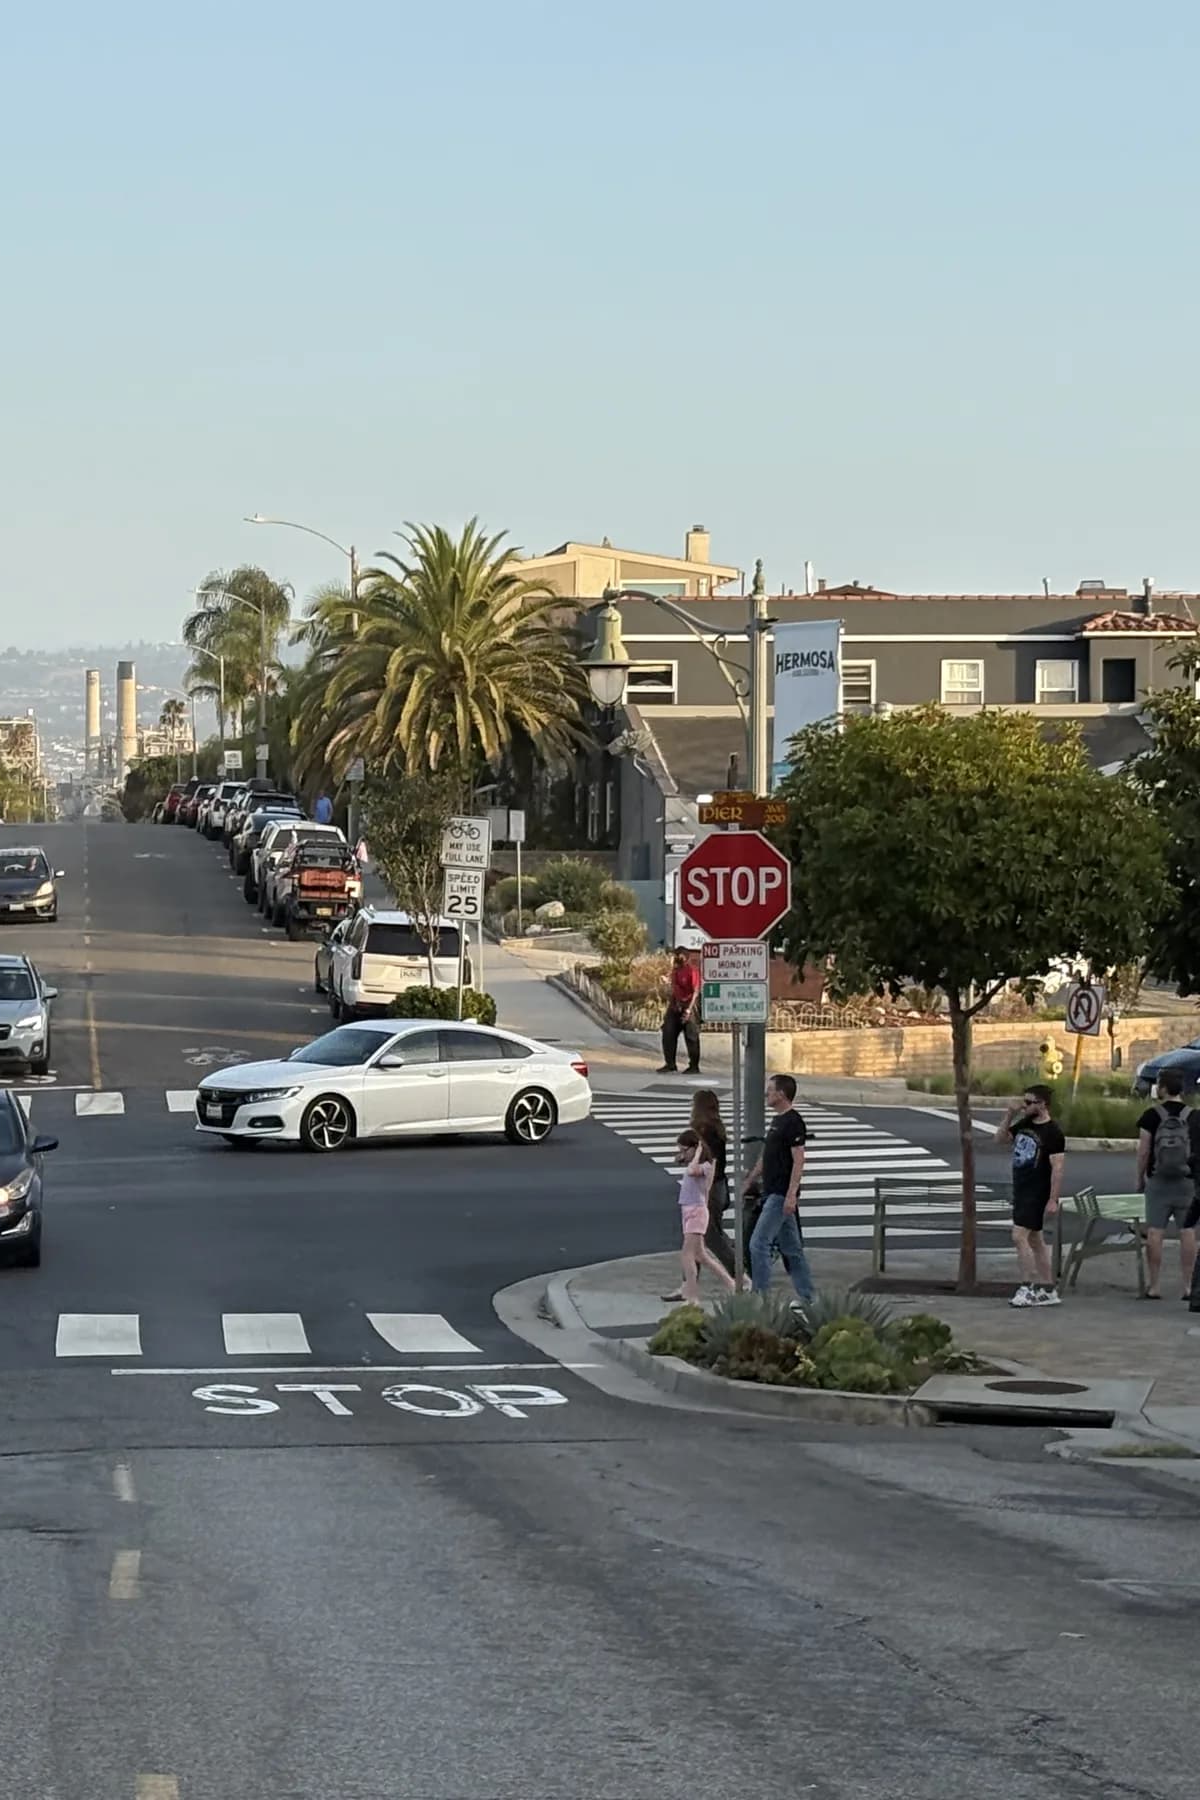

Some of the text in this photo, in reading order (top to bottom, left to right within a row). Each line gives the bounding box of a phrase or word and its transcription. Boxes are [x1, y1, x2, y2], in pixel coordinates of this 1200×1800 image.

[775, 651, 835, 675] HERMOSA
[702, 806, 743, 822] PIER
[449, 842, 481, 851] MAY USE
[445, 852, 485, 864] FULL LANE
[447, 873, 480, 884] SPEED
[450, 884, 477, 894] LIMIT
[686, 866, 782, 907] STOP
[447, 895, 478, 915] 25
[703, 944, 763, 957] NO PARKING
[718, 960, 752, 969] MONDAY
[191, 1383, 569, 1419] STOP
